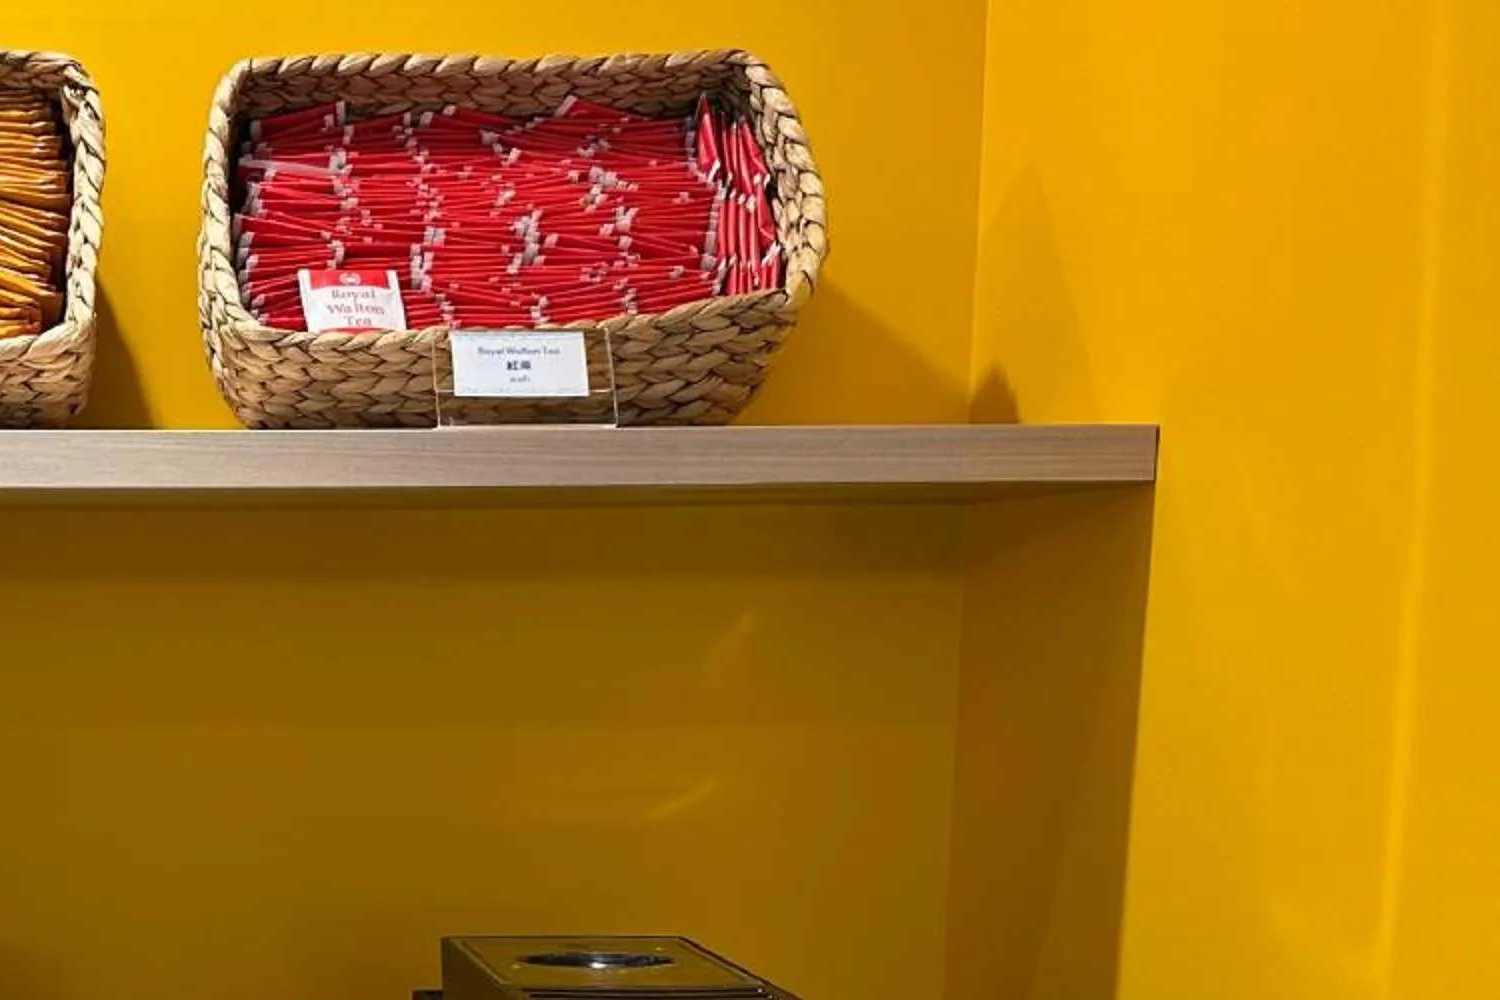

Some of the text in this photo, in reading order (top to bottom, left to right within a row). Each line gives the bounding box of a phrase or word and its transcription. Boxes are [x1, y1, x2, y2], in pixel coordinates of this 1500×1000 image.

[331, 288, 377, 304] Royal
[326, 302, 386, 316] Walton
[343, 315, 373, 326] Tea
